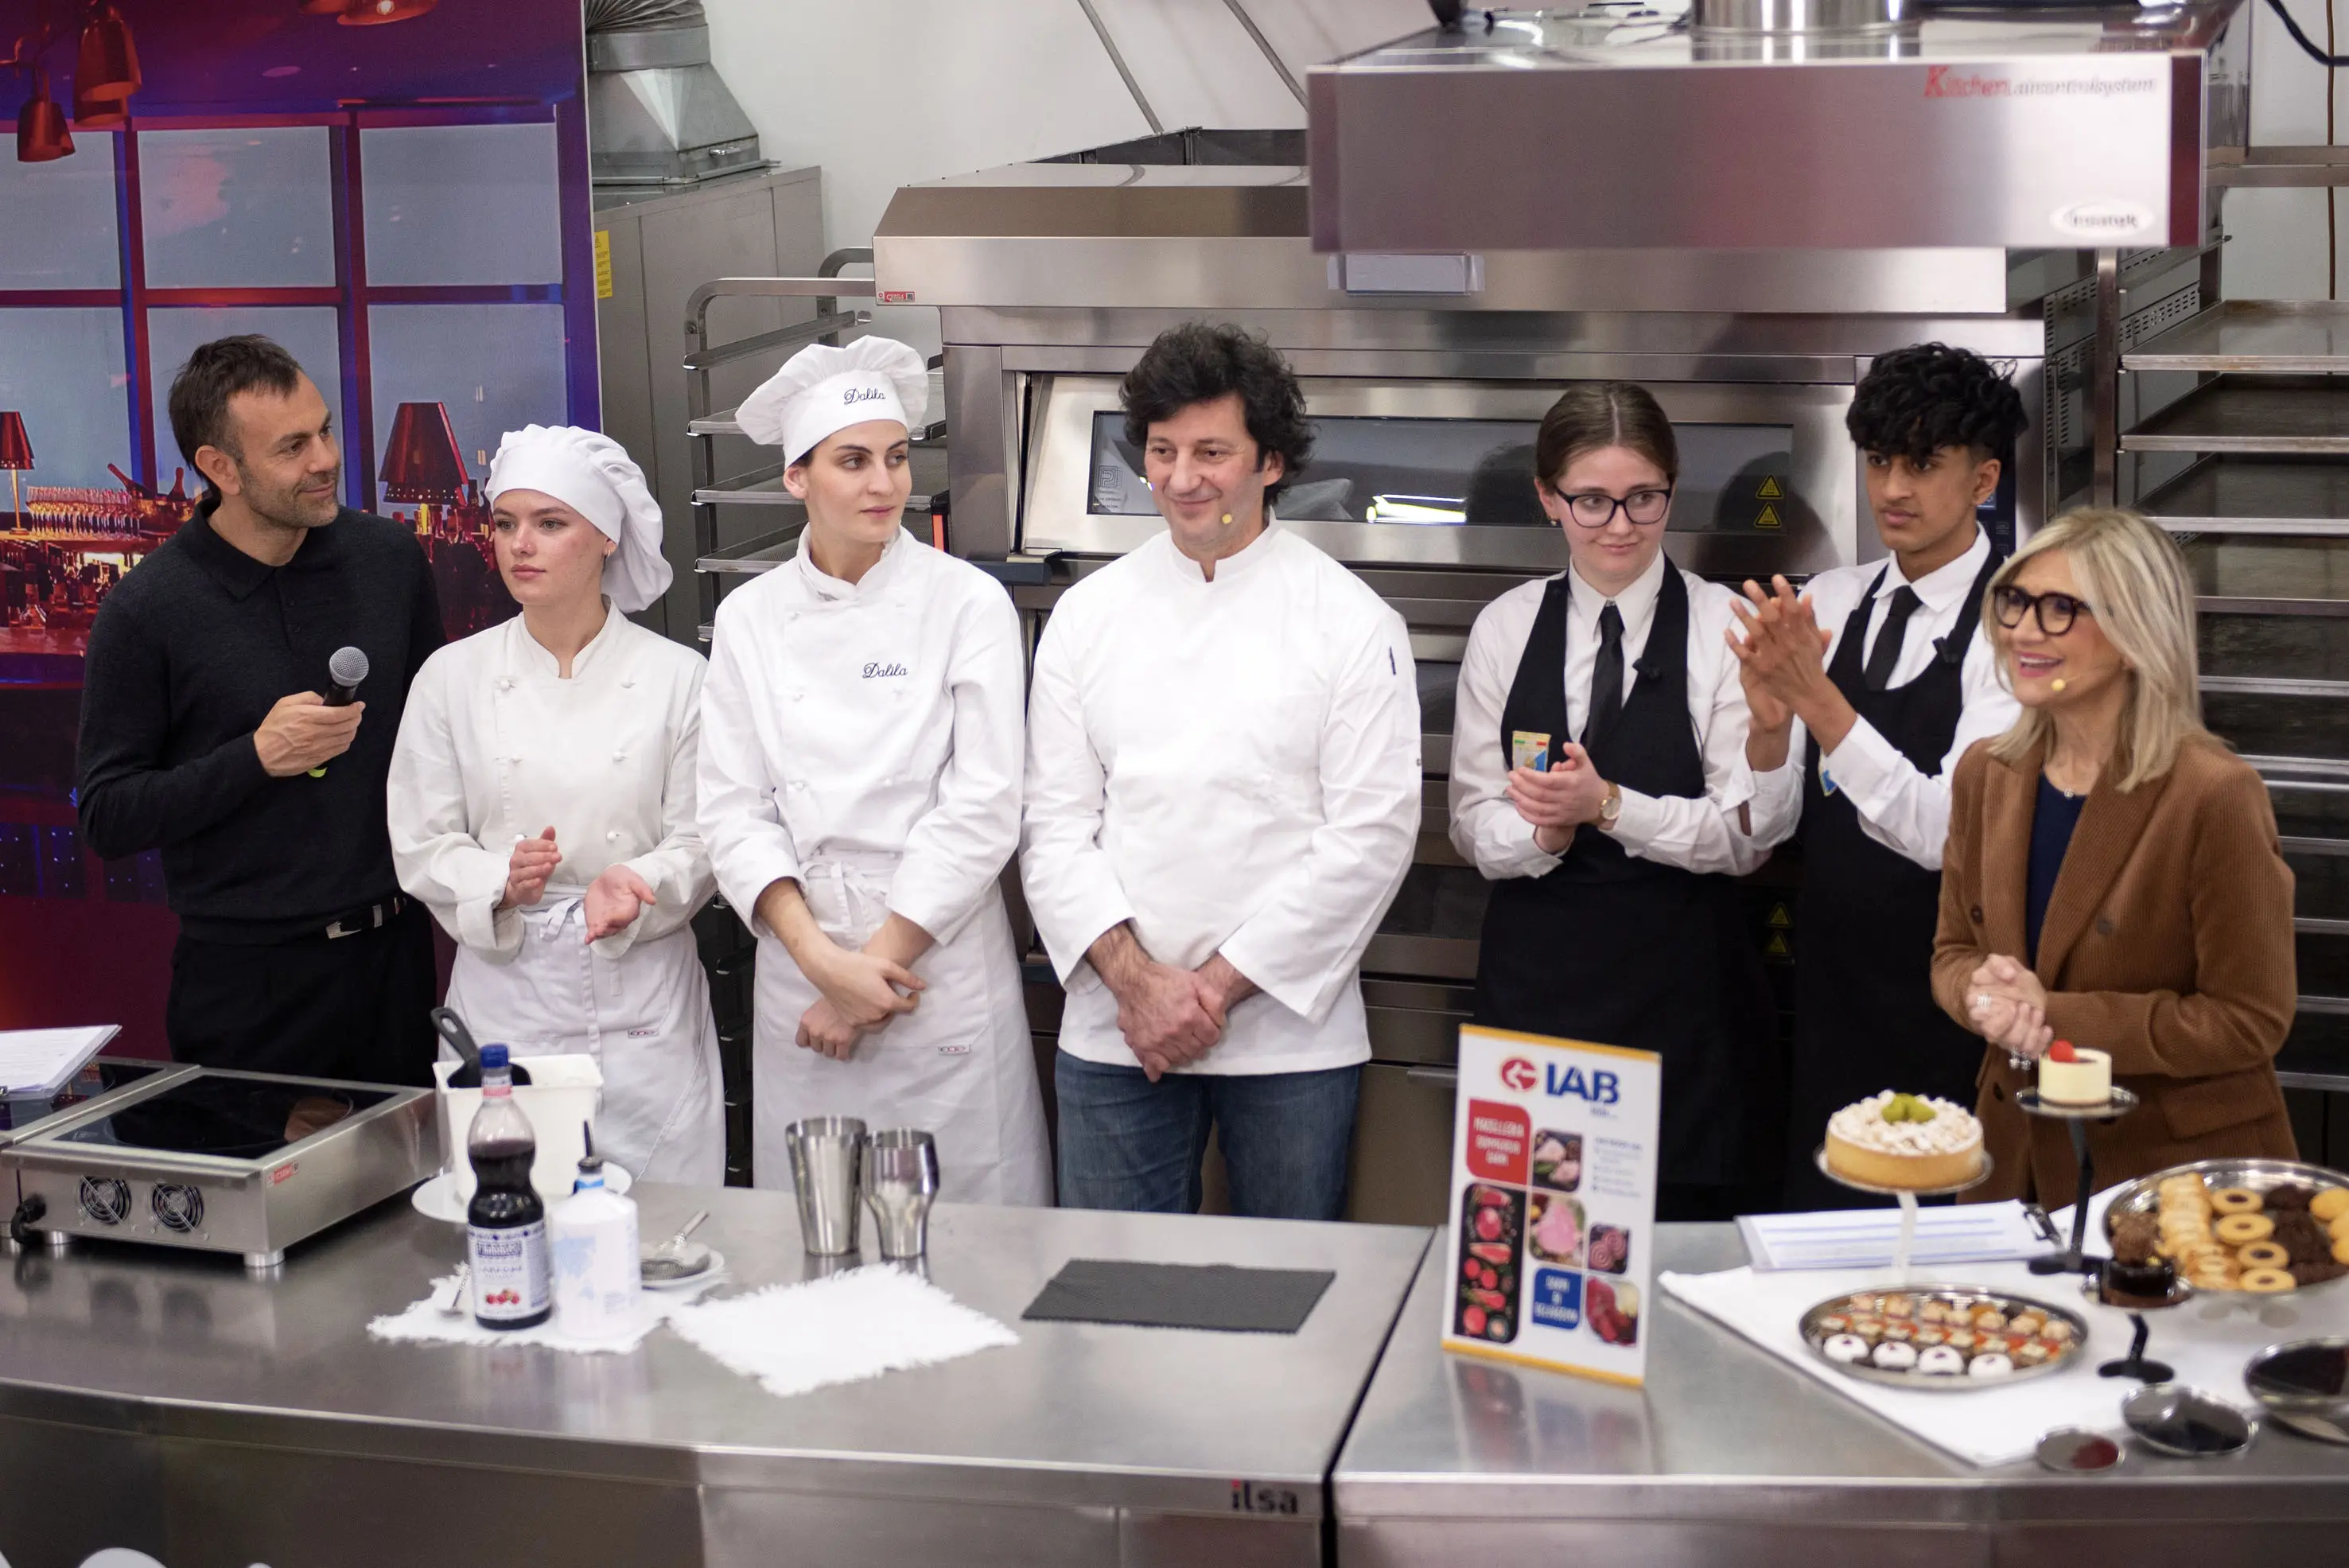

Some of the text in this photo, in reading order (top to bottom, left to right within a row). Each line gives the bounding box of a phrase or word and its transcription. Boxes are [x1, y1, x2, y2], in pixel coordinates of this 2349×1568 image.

[844, 388, 886, 405] Dalila
[862, 663, 908, 679] Dalila
[1231, 1479, 1298, 1514] ilsa
